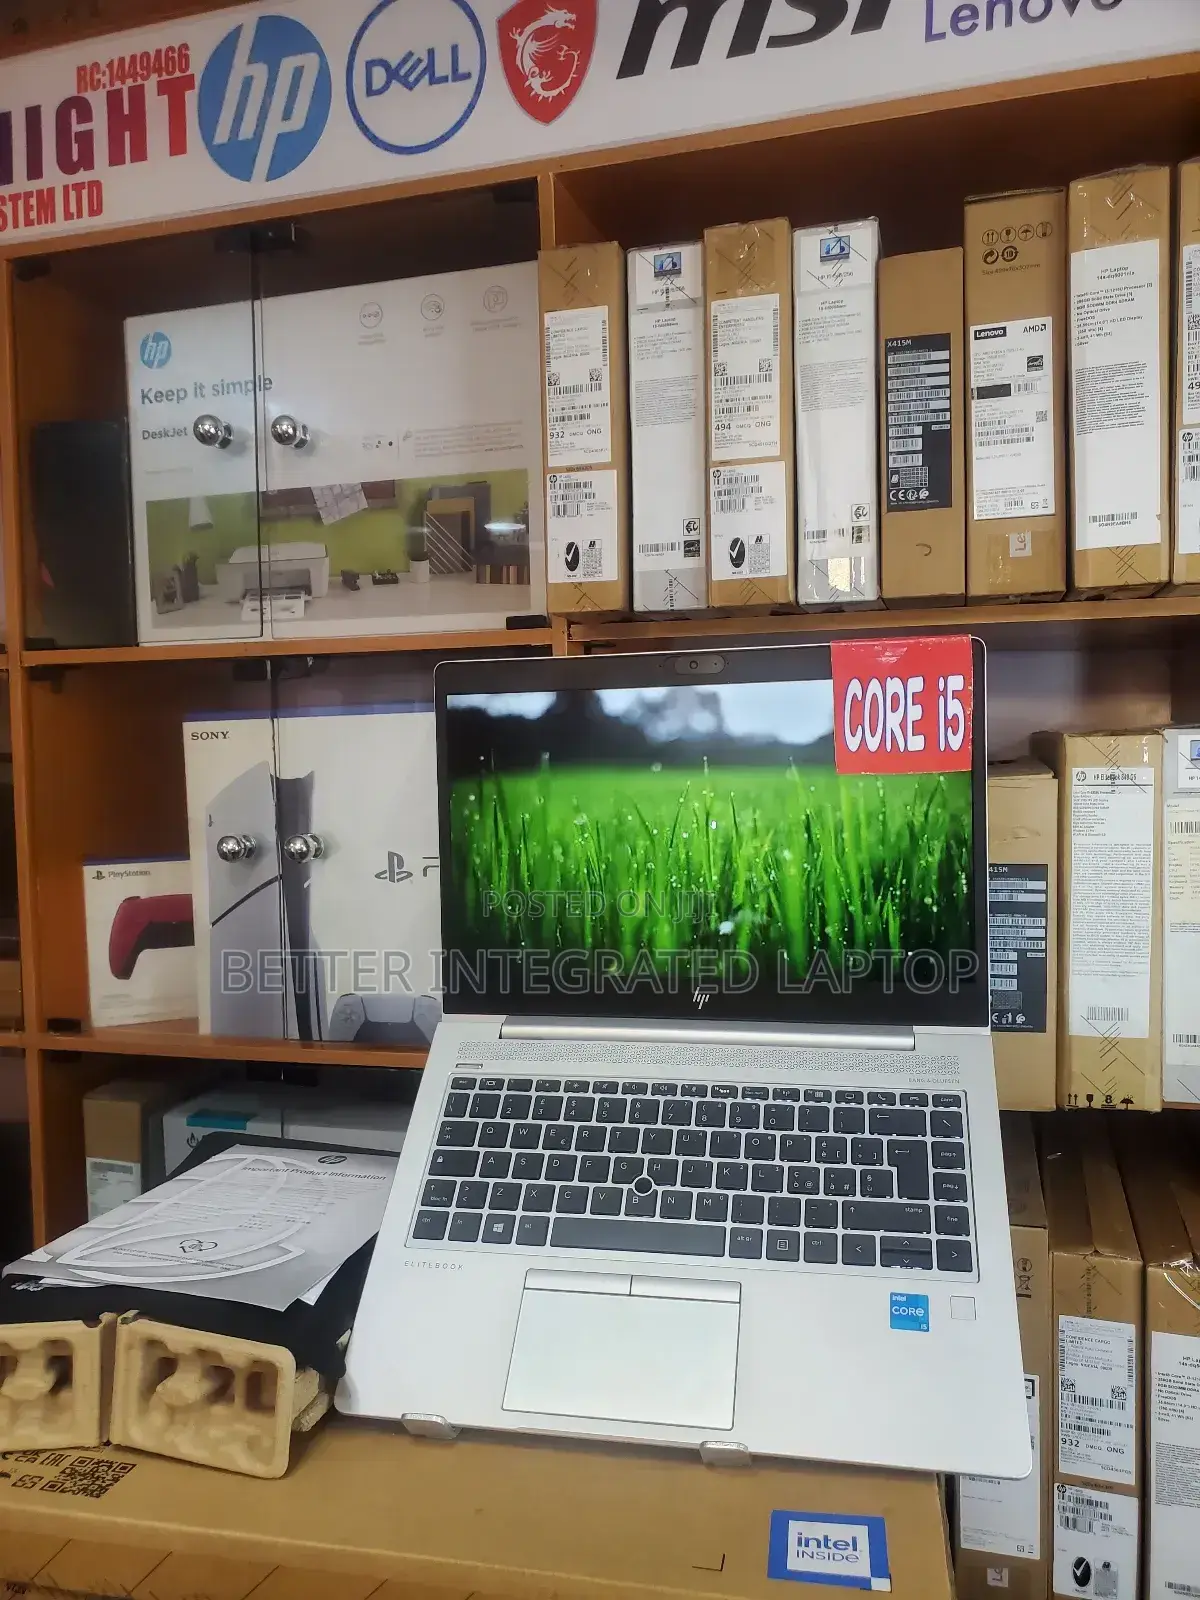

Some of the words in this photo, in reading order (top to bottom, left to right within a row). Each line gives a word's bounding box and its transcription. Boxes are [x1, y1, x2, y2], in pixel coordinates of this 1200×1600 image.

[76, 42, 191, 94] RC:1449466
[363, 43, 472, 98] DELL
[213, 16, 319, 183] hp
[62, 179, 103, 222] LTD
[976, 329, 1004, 339] Lenovo
[1023, 325, 1039, 334] AMD
[138, 331, 172, 370] hp
[887, 339, 912, 348] X415M
[140, 387, 188, 405] Keep
[193, 382, 205, 398] it
[211, 374, 273, 398] simple
[141, 426, 188, 440] DeskJet
[715, 422, 732, 431] 494
[755, 420, 772, 428] ONG
[549, 431, 565, 439] 932
[586, 428, 602, 436] ONG
[844, 676, 926, 753] CORE
[938, 674, 966, 752] i5
[190, 730, 230, 741] SONY
[108, 870, 150, 879] PlayStation
[701, 1114, 708, 1122] 8
[486, 1127, 494, 1135] Q
[582, 1130, 589, 1138] R
[616, 1131, 622, 1139] T
[682, 1134, 690, 1142] U
[487, 1157, 495, 1165] A
[520, 1158, 526, 1166] S
[552, 1159, 560, 1167] D
[620, 1162, 628, 1170] G
[653, 1163, 661, 1171] H
[688, 1165, 694, 1173] J
[723, 1168, 731, 1176] K
[290, 1168, 328, 1177] Product
[328, 1171, 387, 1181] Information
[496, 1188, 504, 1196] Z
[530, 1189, 538, 1197] X
[564, 1191, 572, 1199] C
[598, 1192, 606, 1200] V
[632, 1196, 639, 1204] B
[703, 1198, 712, 1206] M
[904, 1206, 923, 1214] stamp
[404, 1260, 464, 1271] ELITEBOOK
[892, 1294, 907, 1302] intel
[1061, 1437, 1080, 1448] 932
[1106, 1446, 1125, 1455] ONG
[797, 1532, 858, 1551] intel
